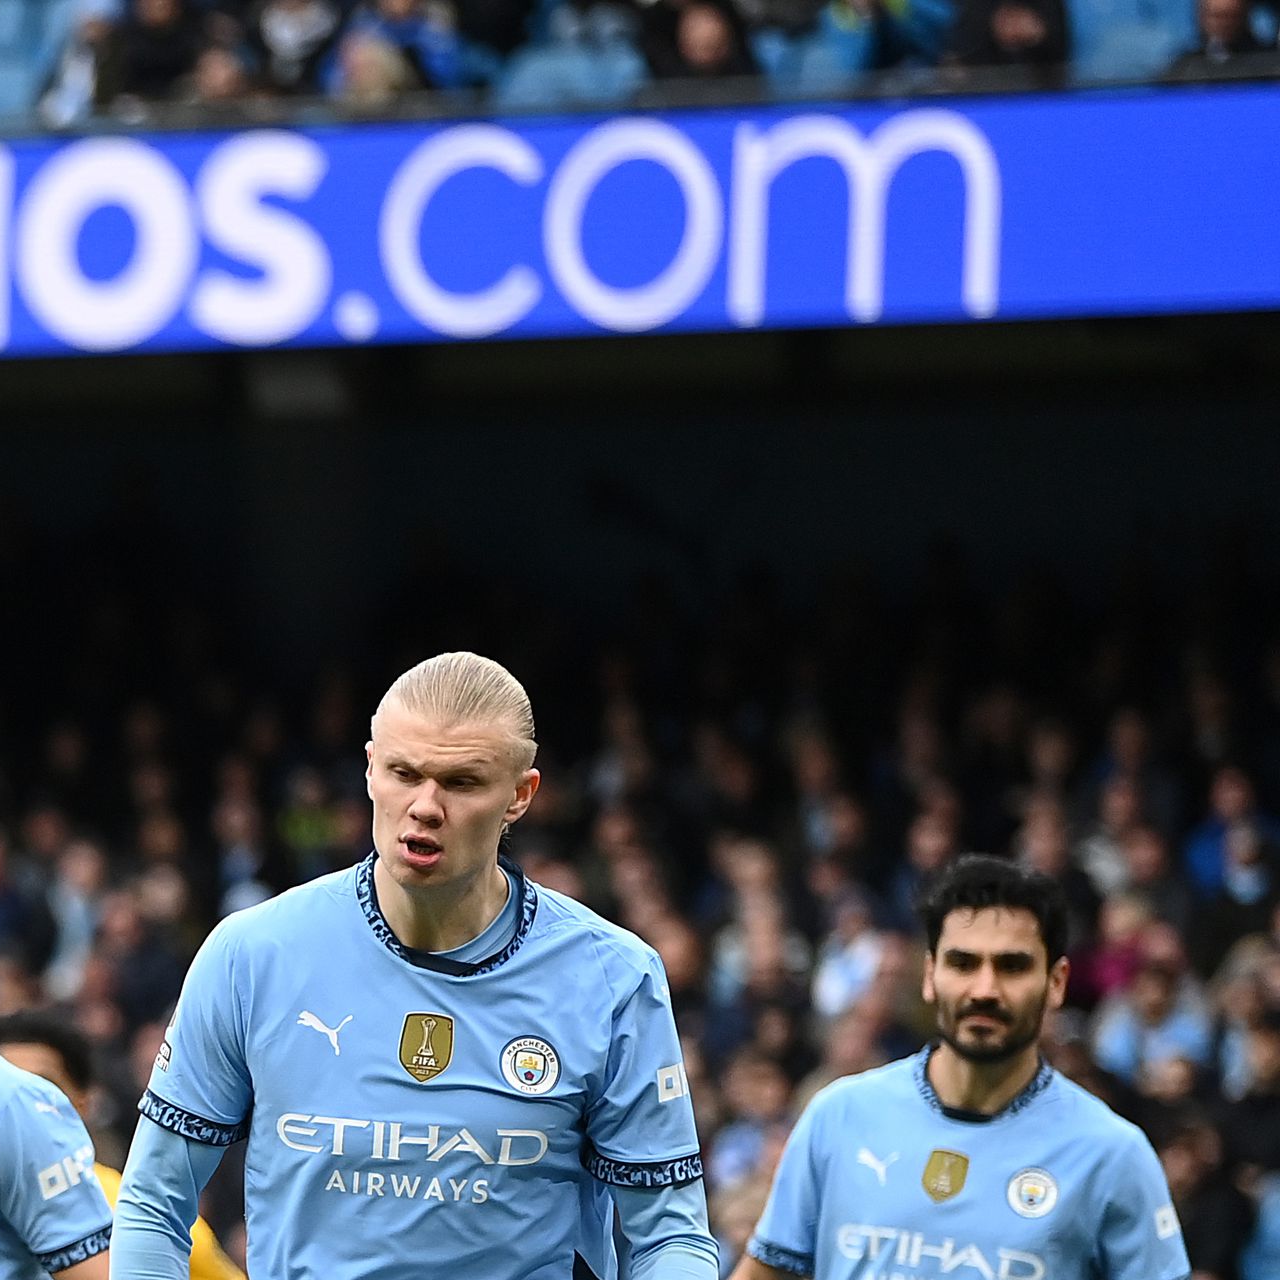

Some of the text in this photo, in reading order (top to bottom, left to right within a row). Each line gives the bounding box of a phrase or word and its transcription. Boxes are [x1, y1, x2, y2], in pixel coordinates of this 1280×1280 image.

[412, 1056, 436, 1066] FIFA
[507, 1040, 556, 1063] MANCHESTER
[276, 1113, 549, 1166] ETIHAD
[325, 1169, 489, 1204] AIRWAYS
